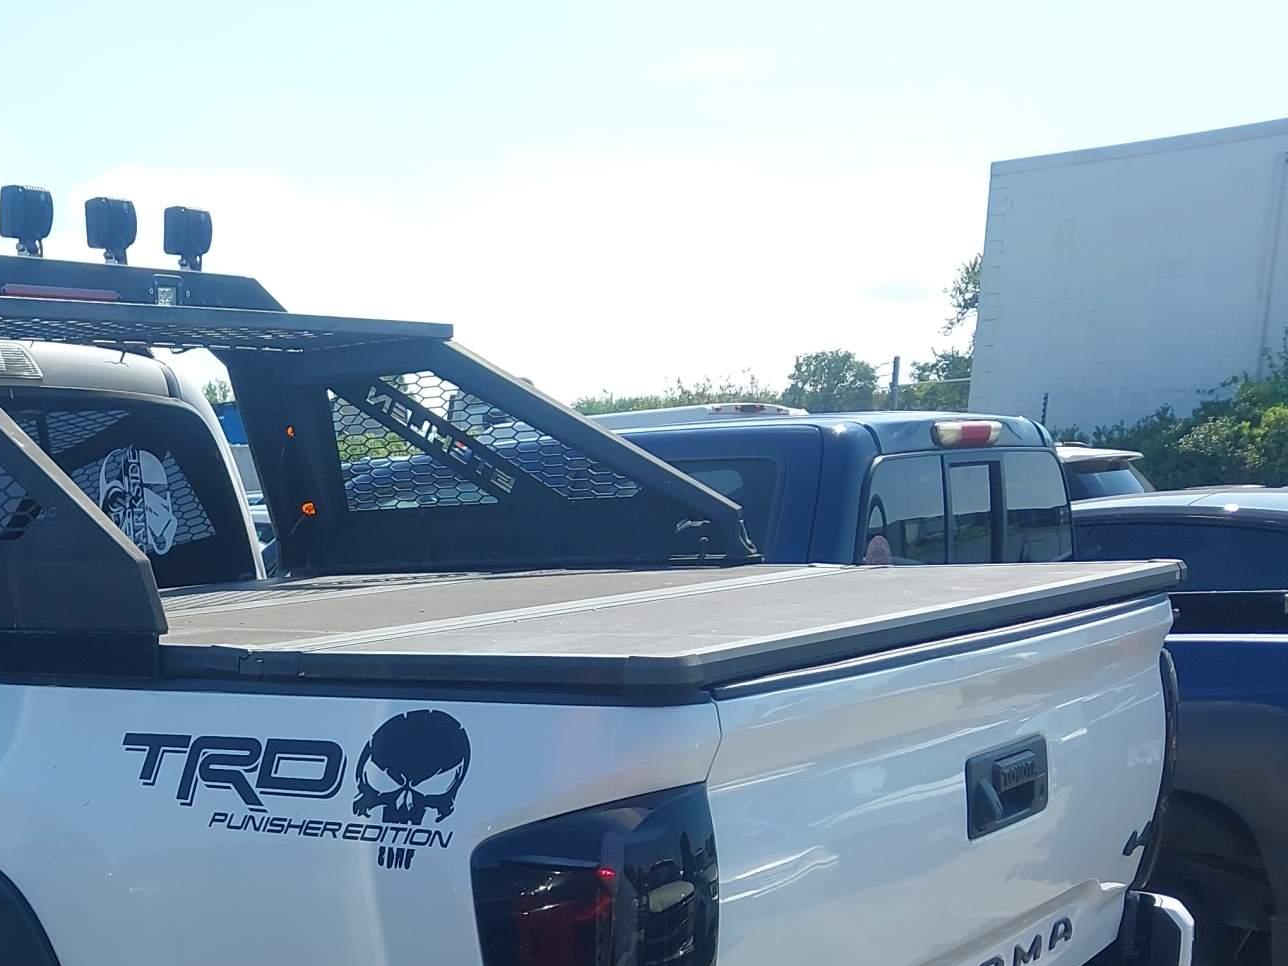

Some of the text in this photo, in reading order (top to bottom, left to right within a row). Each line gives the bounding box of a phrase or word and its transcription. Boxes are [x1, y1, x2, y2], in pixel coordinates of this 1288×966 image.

[122, 732, 347, 812] TRD
[208, 812, 454, 848] PUNISHER EDITION
